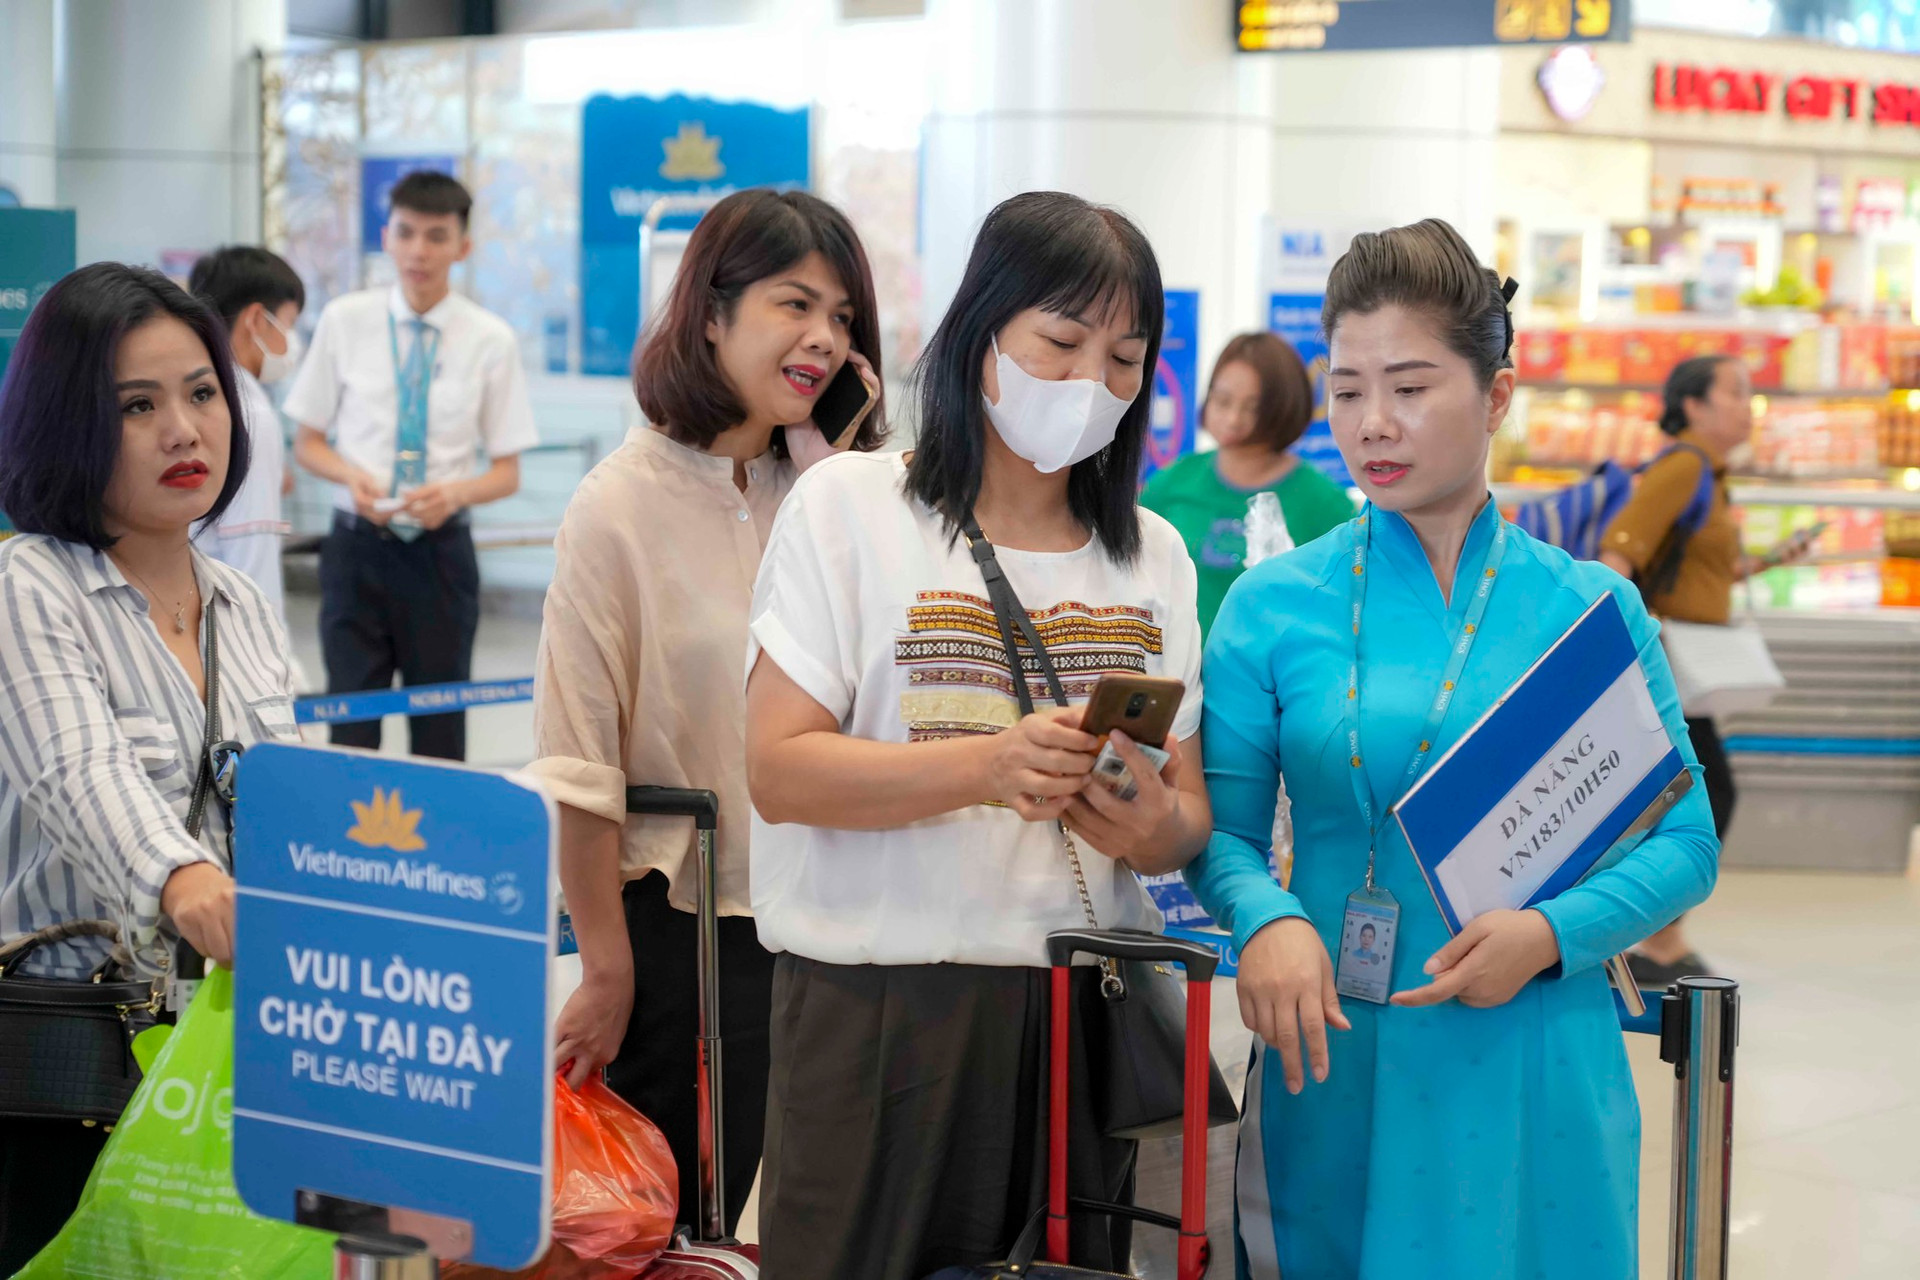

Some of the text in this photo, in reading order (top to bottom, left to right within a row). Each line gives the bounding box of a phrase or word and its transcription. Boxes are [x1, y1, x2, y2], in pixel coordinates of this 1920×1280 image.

[1653, 62, 1920, 128] LUCKY GIFT SH
[1478, 577, 1491, 598] VIAGS
[1458, 634, 1470, 655] VIAGS
[1436, 690, 1450, 712] VIAGS
[1498, 749, 1621, 882] VN183/10H50
[1500, 800, 1533, 841] ĐÀ
[285, 945, 471, 1014] VUI LÒNG
[259, 996, 512, 1076] CHỜ TẠI ĐÂY
[291, 1048, 478, 1110] PLEASE WAIT
